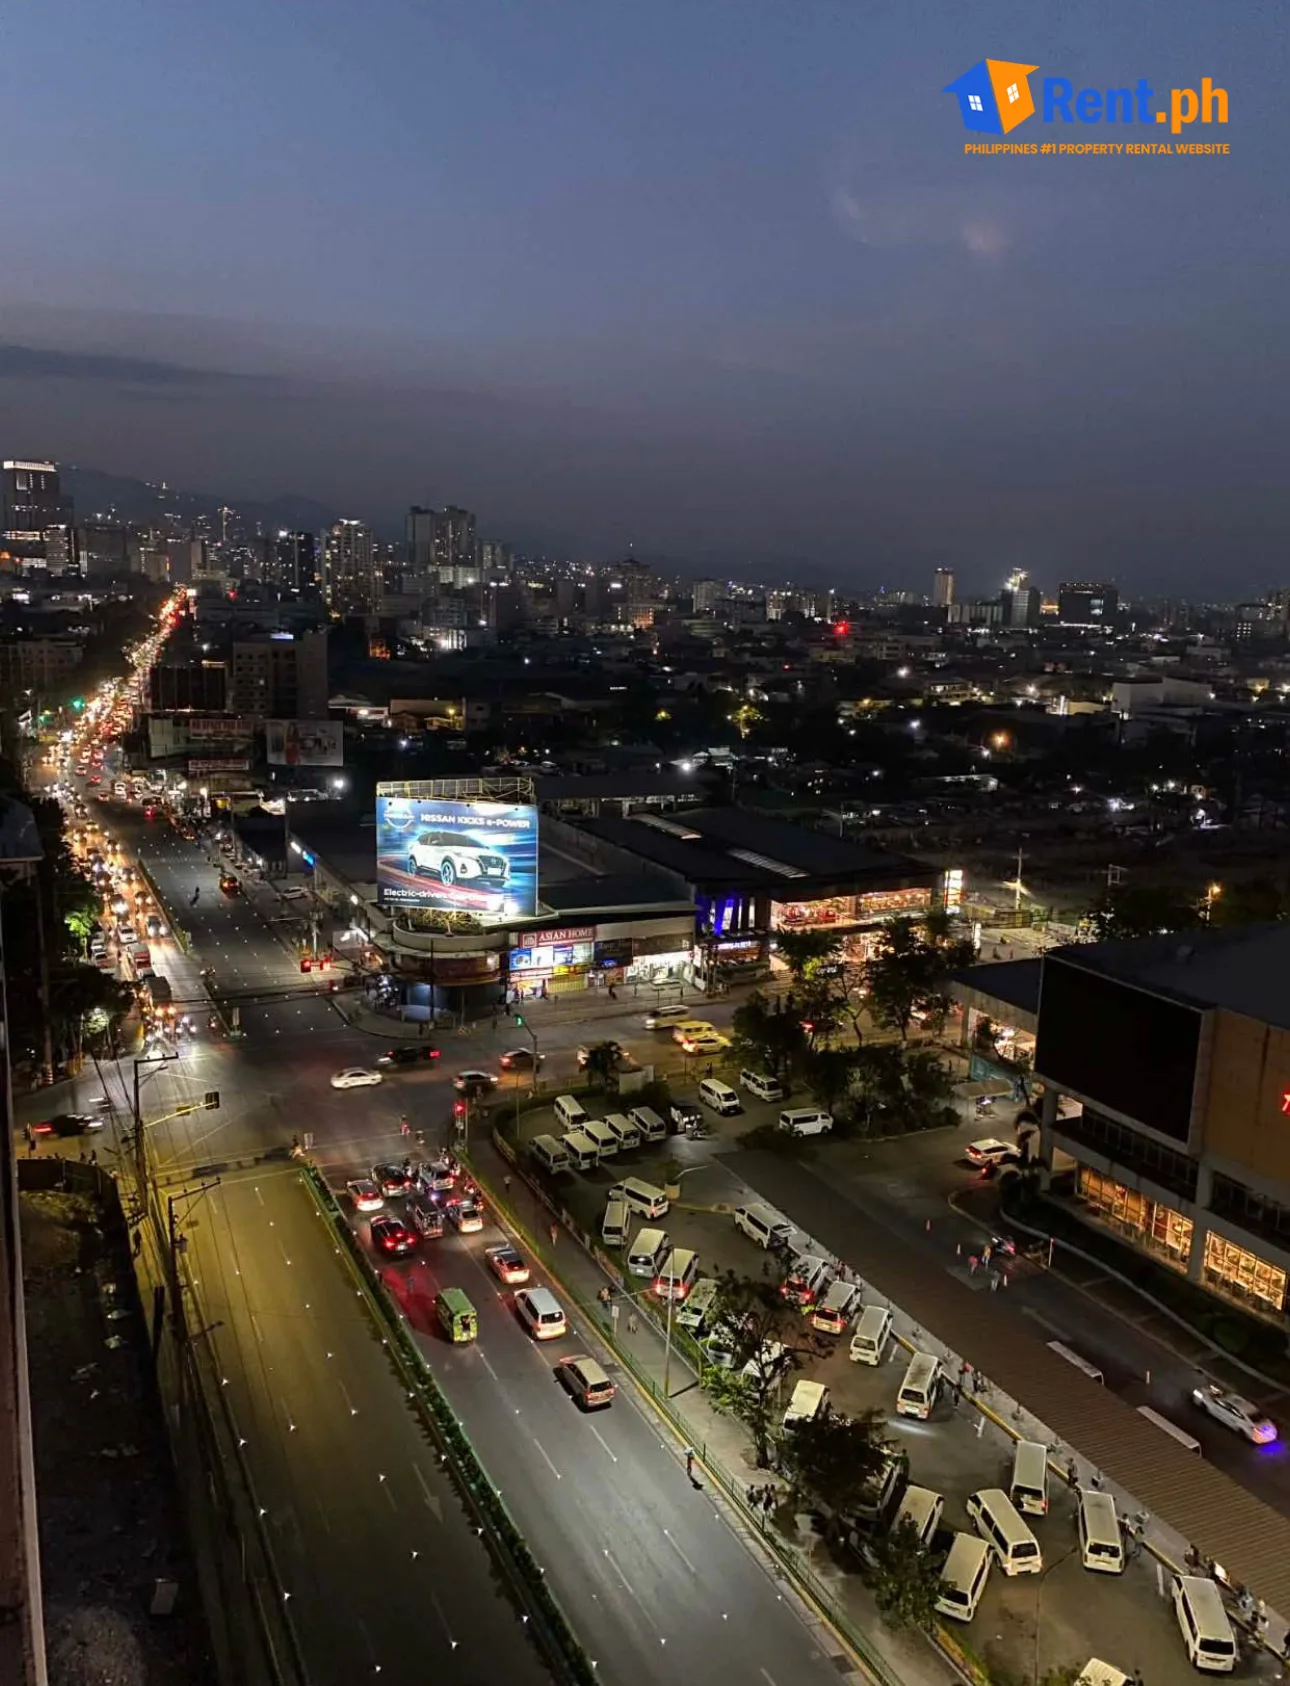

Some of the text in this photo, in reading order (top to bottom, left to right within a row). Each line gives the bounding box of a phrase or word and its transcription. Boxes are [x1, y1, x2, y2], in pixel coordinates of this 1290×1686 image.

[420, 813, 456, 824] NISSAN
[457, 816, 485, 826] KICKS
[540, 928, 595, 941] ASIAN HOME
